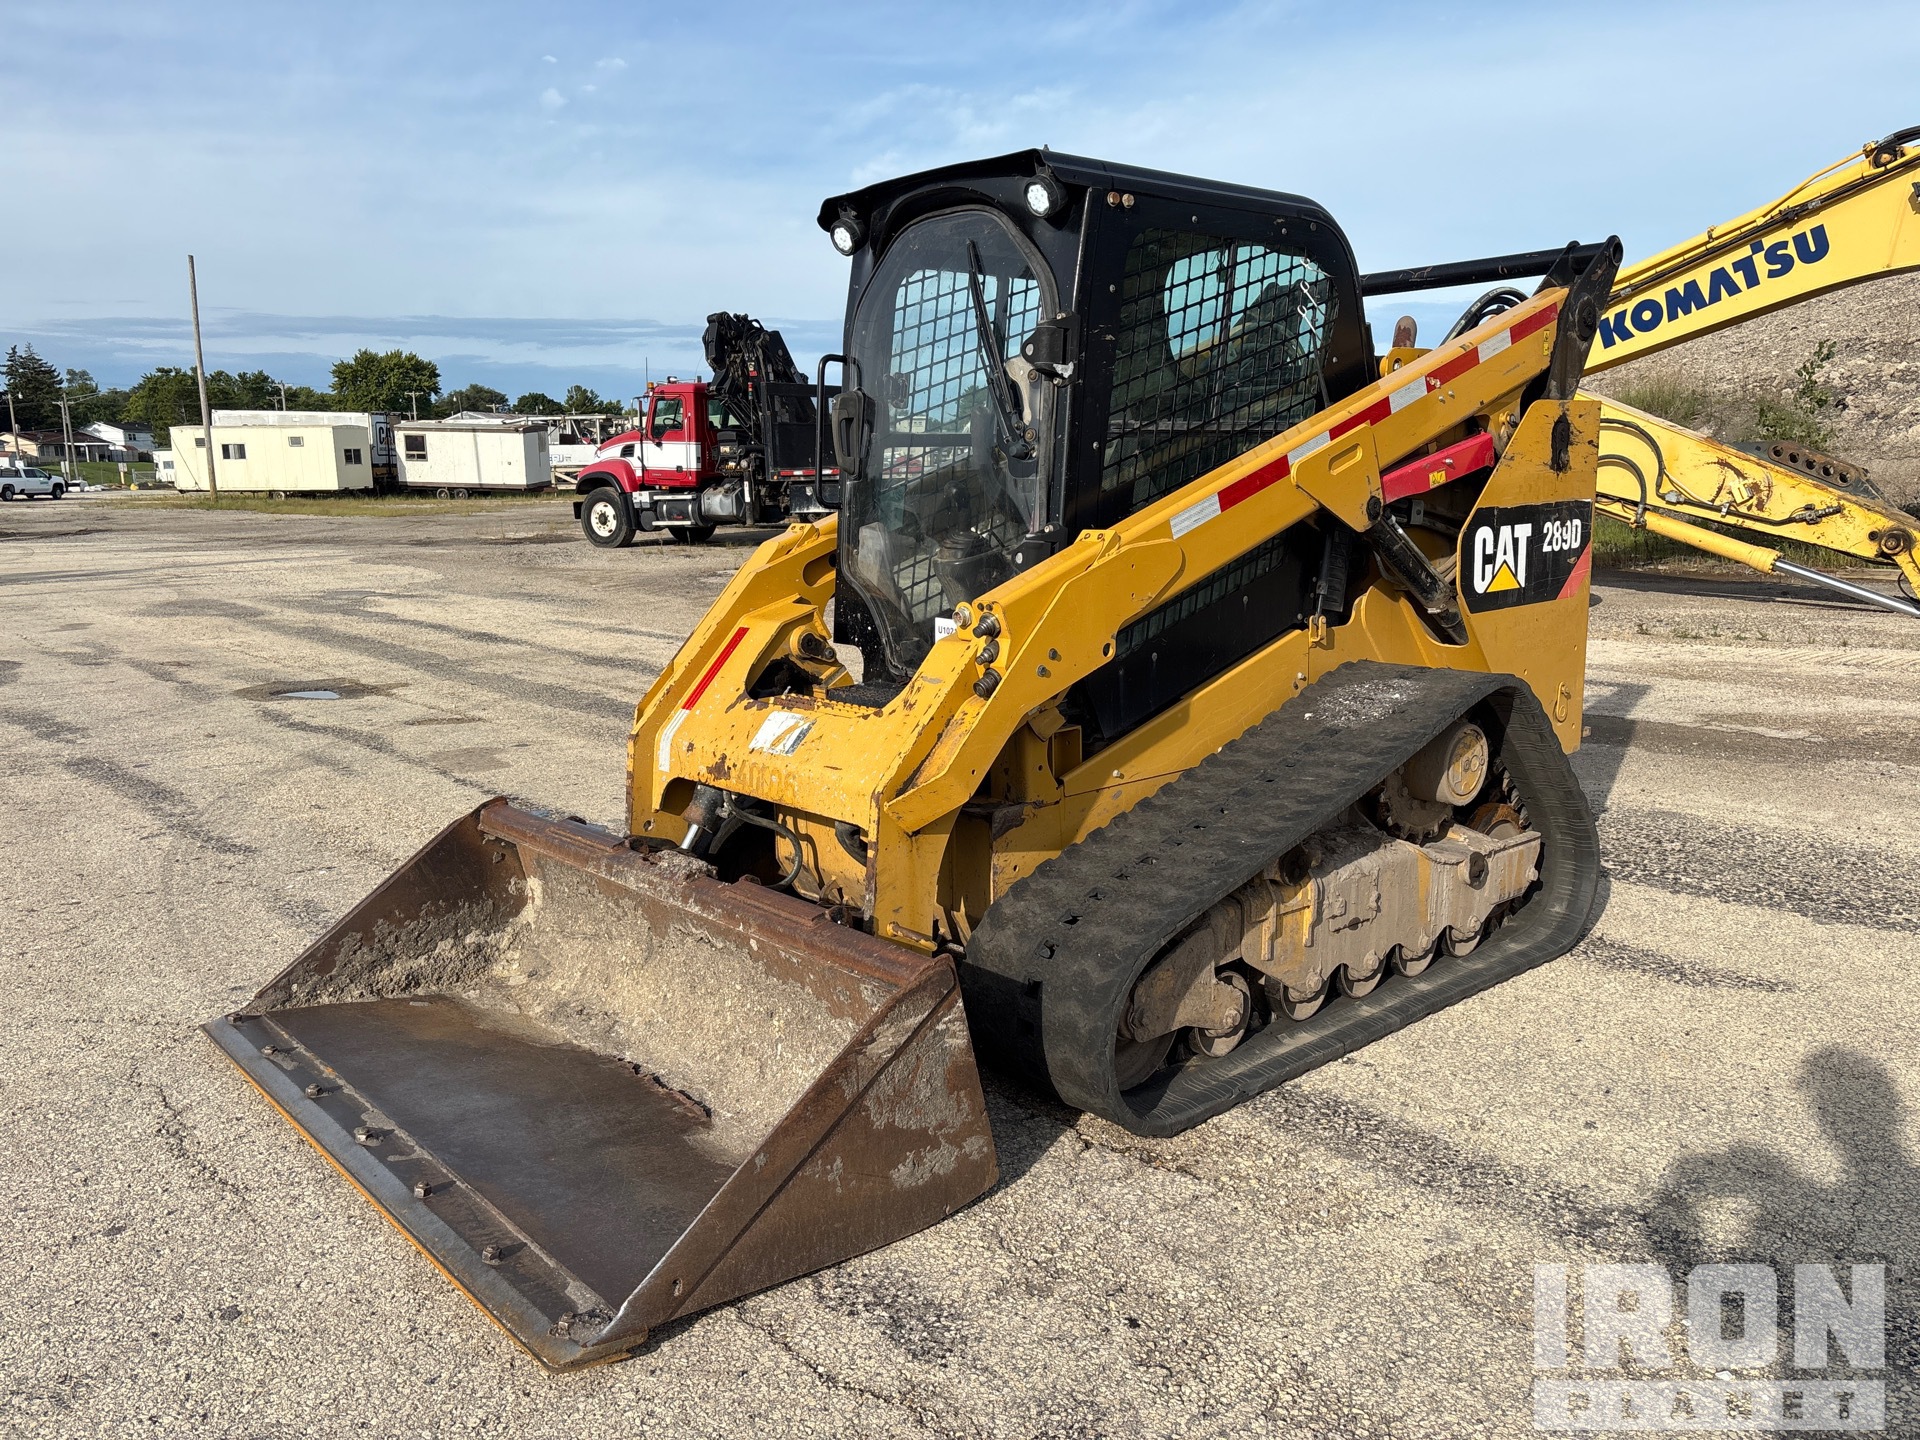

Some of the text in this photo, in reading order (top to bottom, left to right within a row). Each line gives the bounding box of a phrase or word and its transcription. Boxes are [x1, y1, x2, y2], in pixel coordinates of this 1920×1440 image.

[1599, 224, 1830, 350] KOMATSU
[1473, 518, 1582, 594] CAT 289D
